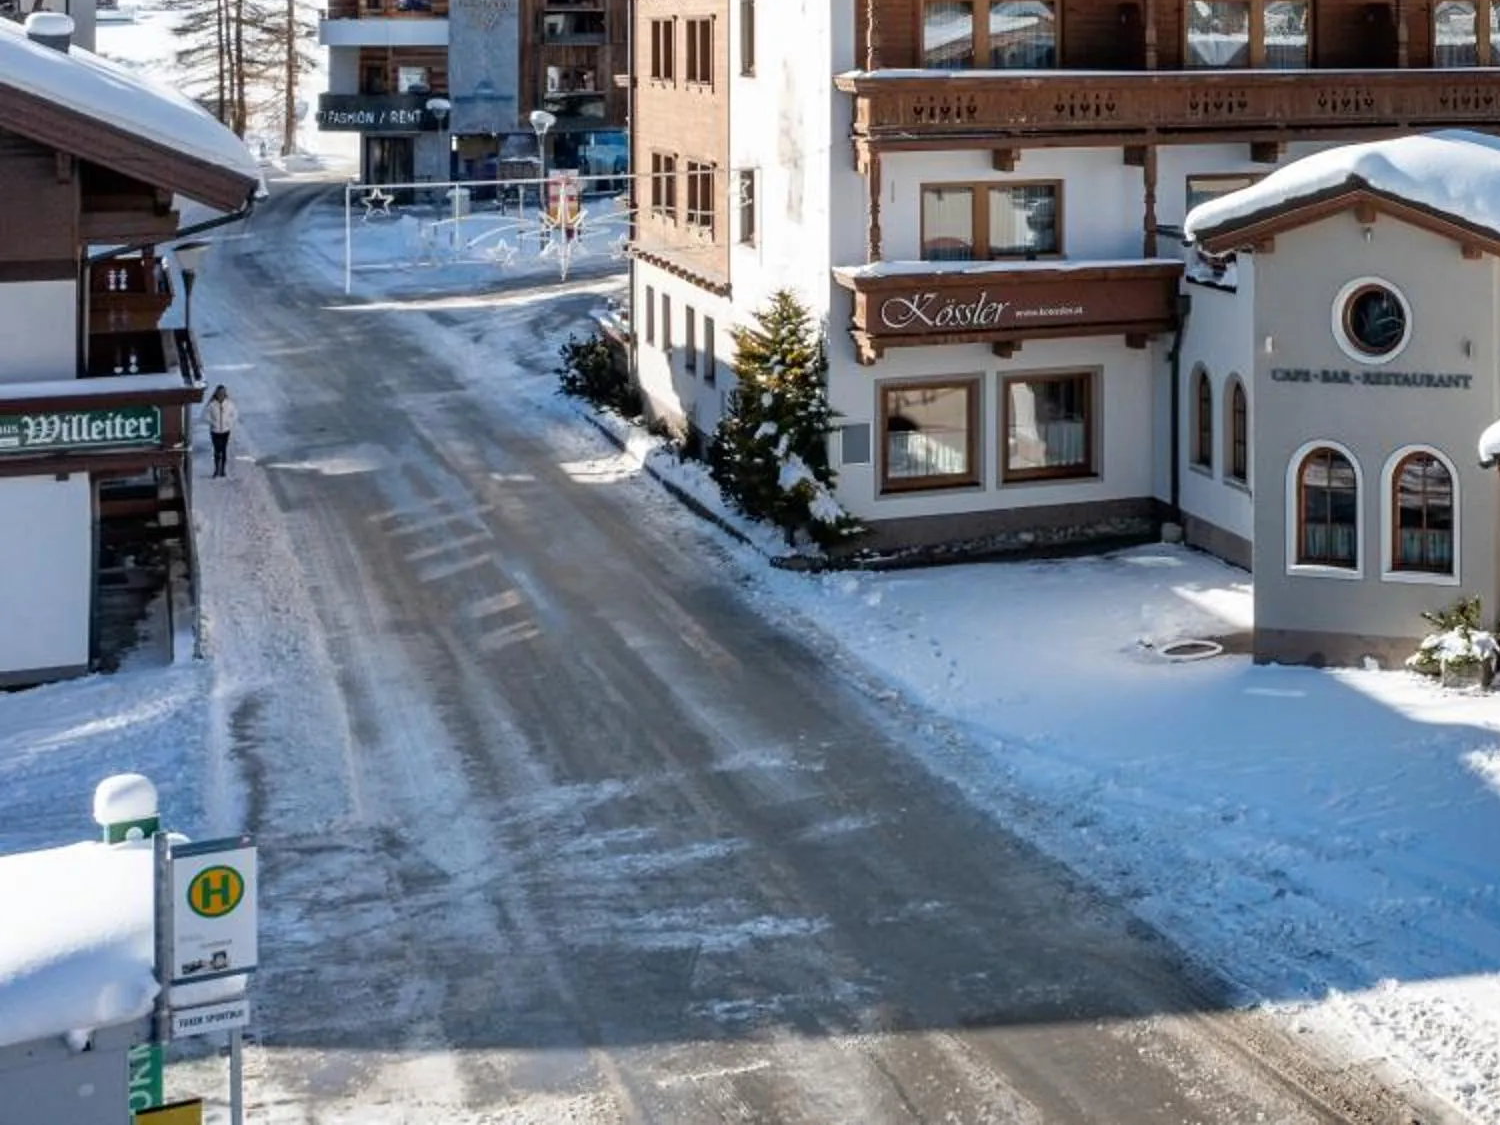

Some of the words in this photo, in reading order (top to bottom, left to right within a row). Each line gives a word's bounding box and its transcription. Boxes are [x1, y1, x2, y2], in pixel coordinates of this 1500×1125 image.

[389, 110, 422, 124] RENT
[881, 291, 1011, 328] Kössler
[1361, 372, 1473, 389] RESTAURANT
[21, 411, 153, 445] Willeiter
[202, 874, 229, 909] H
